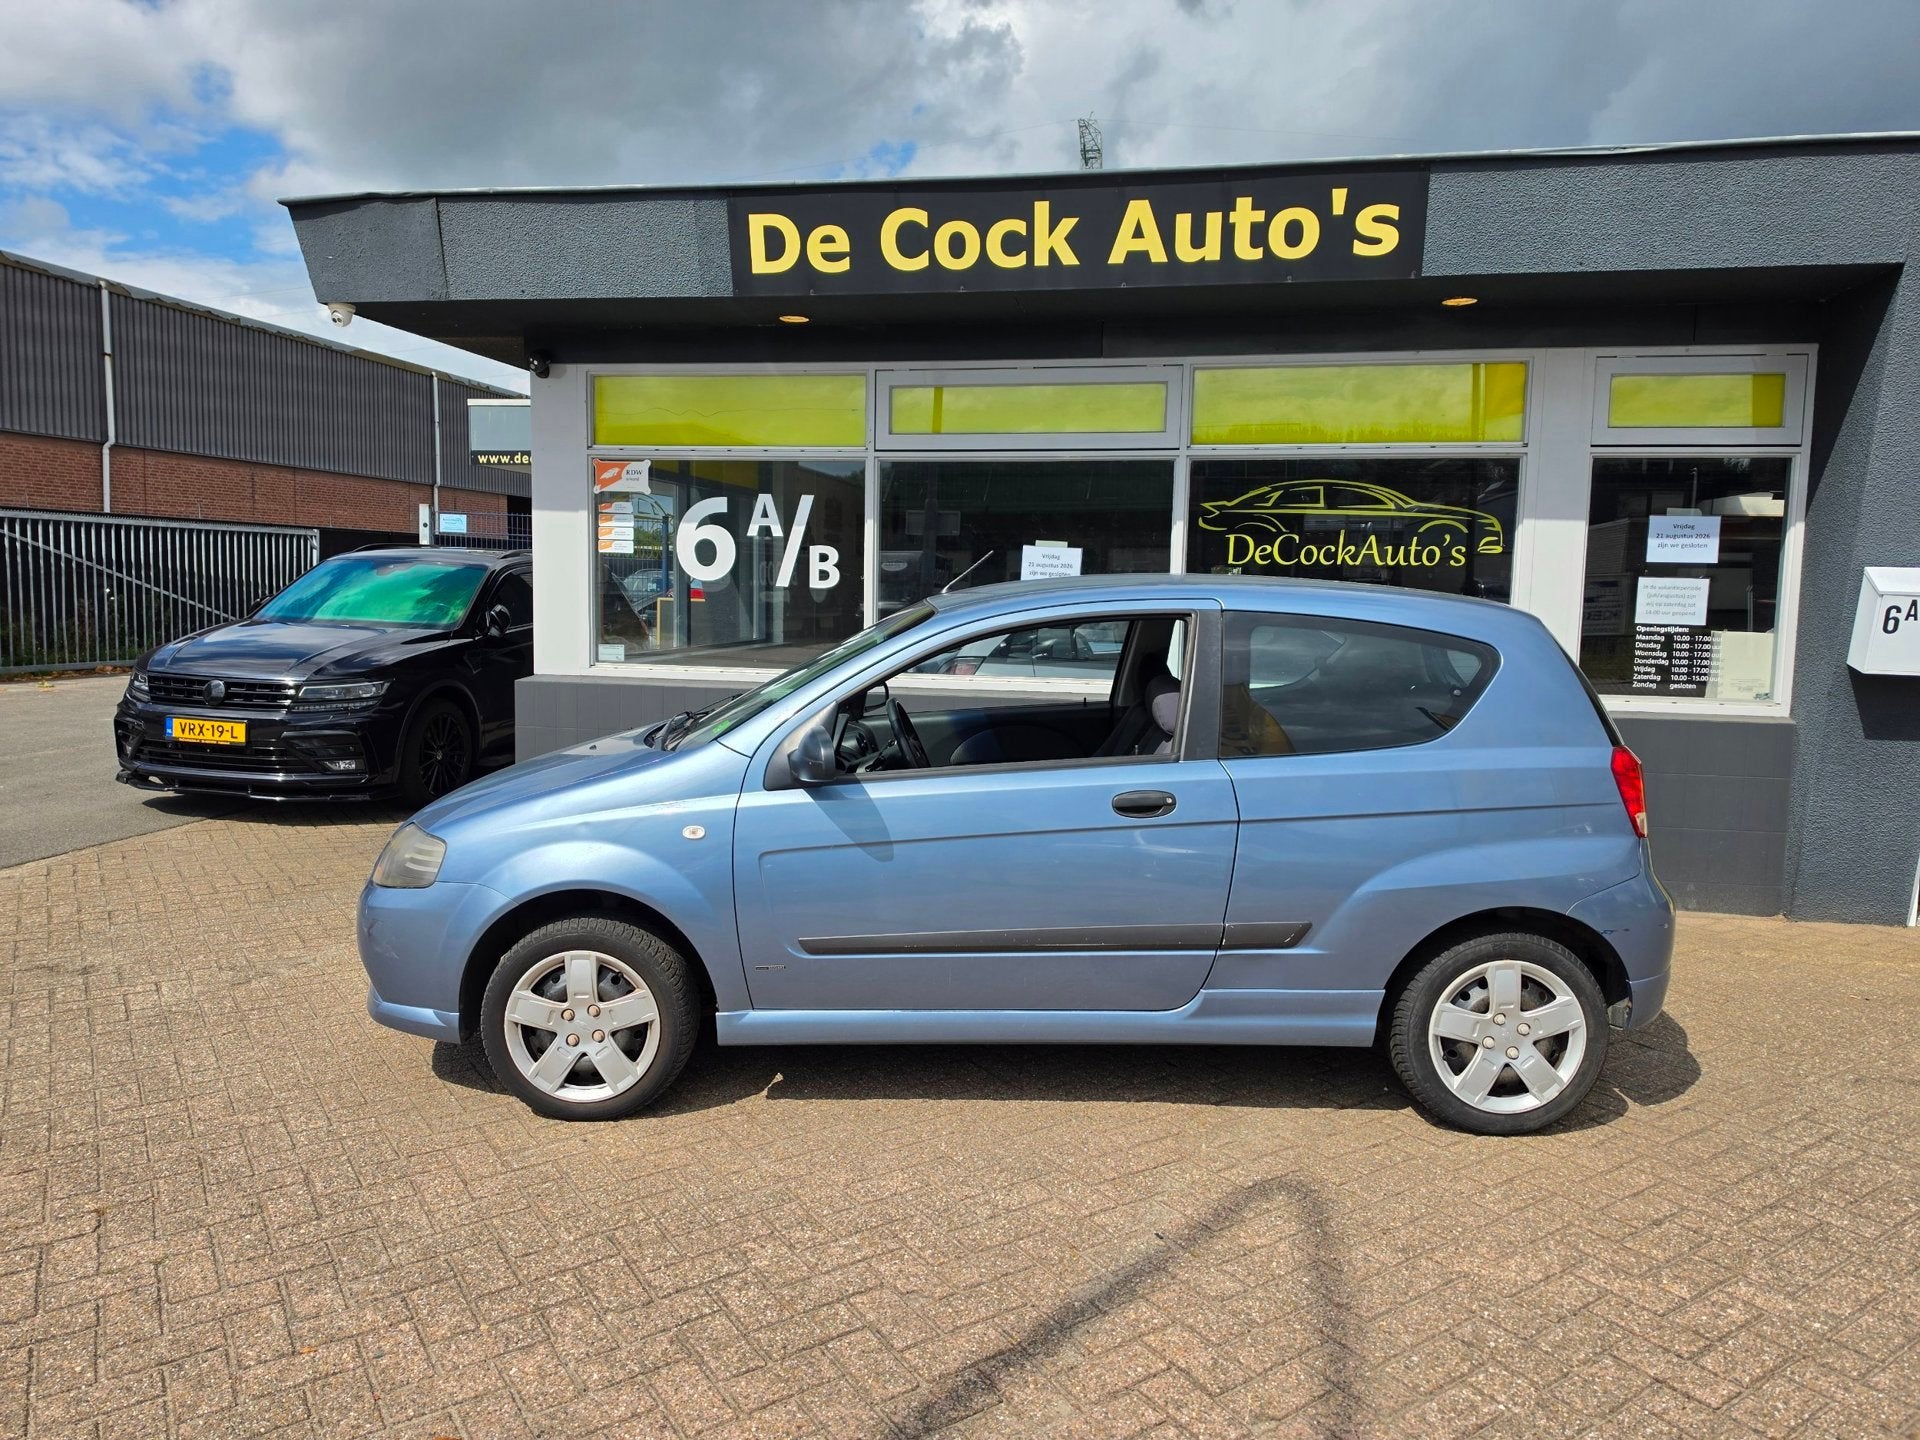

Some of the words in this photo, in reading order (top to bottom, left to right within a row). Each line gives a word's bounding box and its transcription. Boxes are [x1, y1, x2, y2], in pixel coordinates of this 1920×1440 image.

[748, 212, 851, 275] De
[881, 200, 1081, 273] Cock
[1107, 187, 1401, 266] Auto's
[1672, 523, 1696, 531] Vrijdag
[1636, 625, 1690, 633] Openingstijden:
[1635, 634, 1665, 642] Maandag
[1634, 650, 1667, 658] Woensdag
[1632, 681, 1656, 689] Zondag
[179, 721, 239, 740] VRX-19-L
